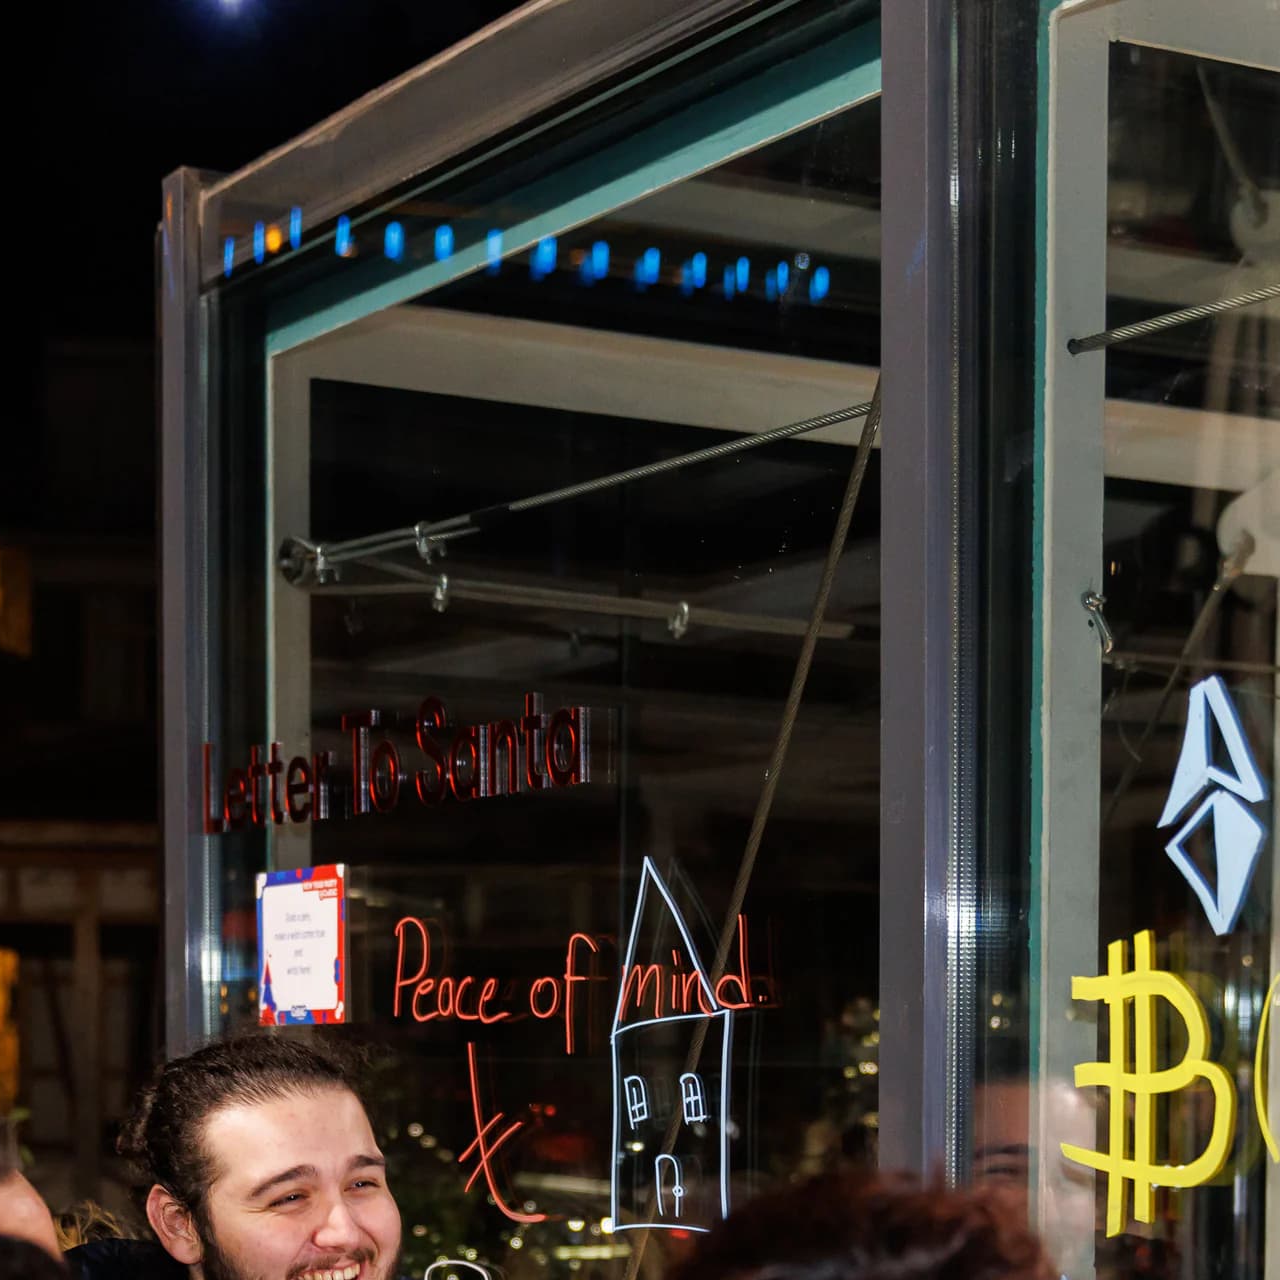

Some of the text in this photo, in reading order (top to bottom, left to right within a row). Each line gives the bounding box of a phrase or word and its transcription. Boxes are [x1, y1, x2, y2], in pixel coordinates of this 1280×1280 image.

[202, 691, 590, 835] Letter To Santa
[392, 916, 512, 1023] Peace
[529, 932, 600, 1056] of
